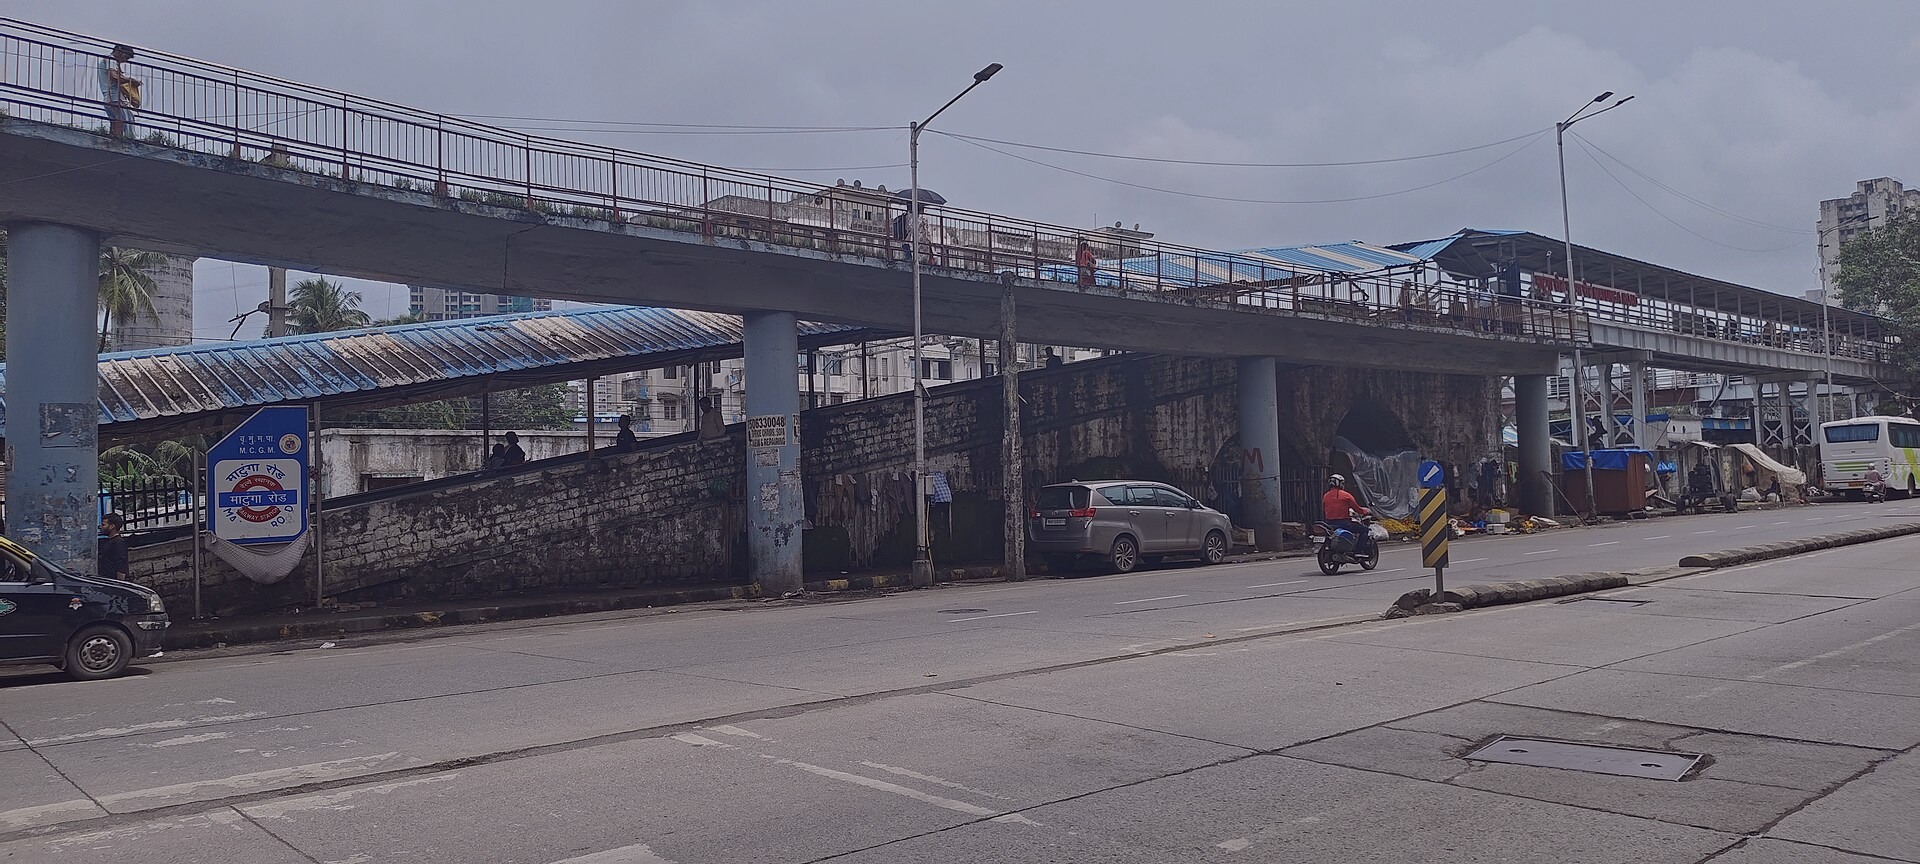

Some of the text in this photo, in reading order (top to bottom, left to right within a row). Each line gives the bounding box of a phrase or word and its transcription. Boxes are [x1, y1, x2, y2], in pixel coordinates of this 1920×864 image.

[225, 463, 286, 481] माटुंगा रोड
[229, 491, 287, 507] माटुंगा रोड
